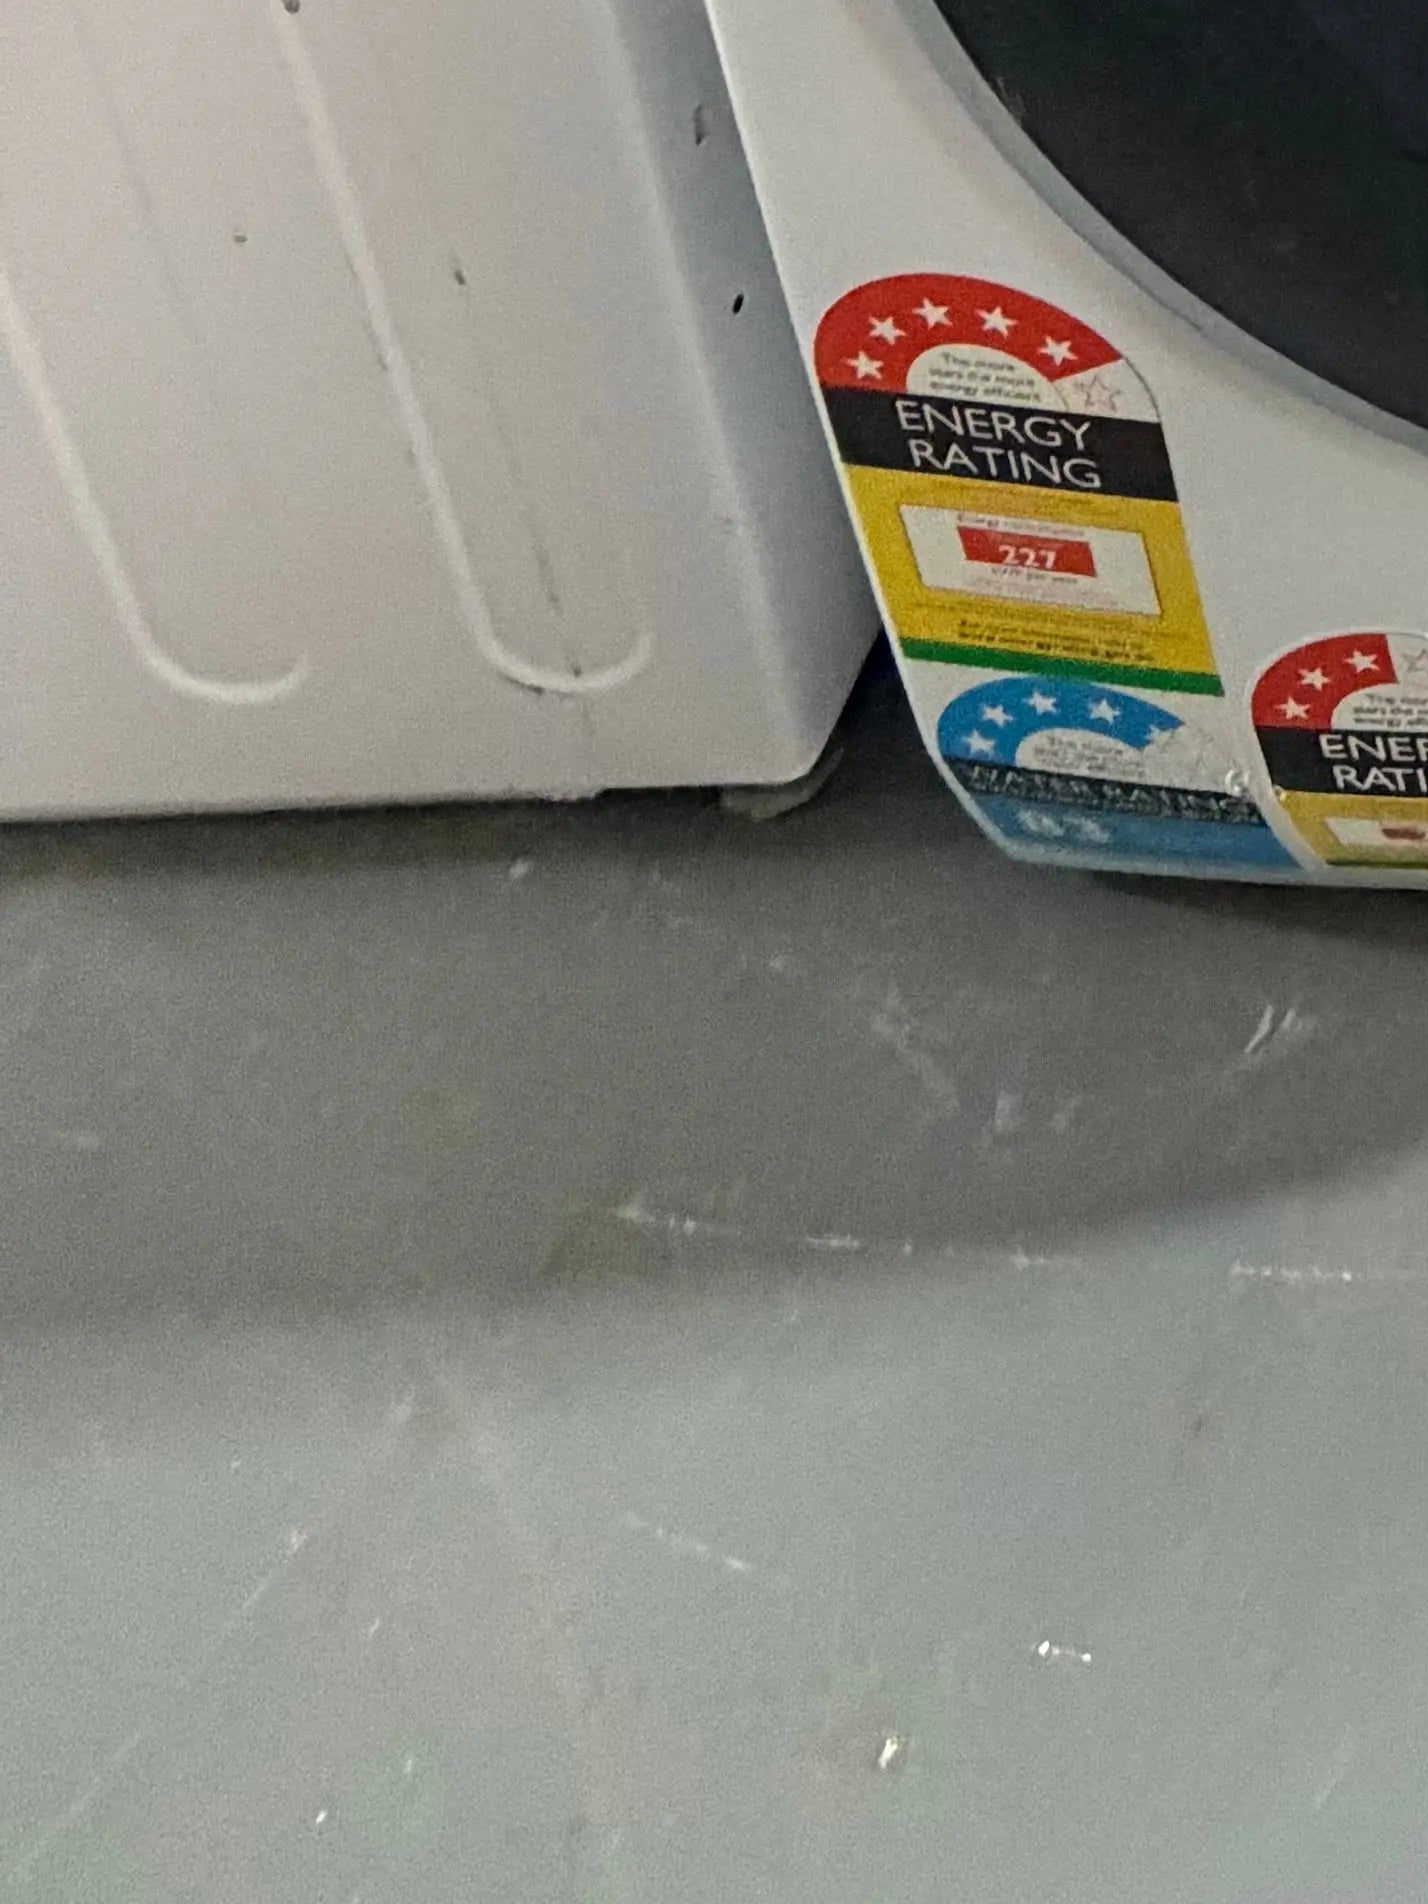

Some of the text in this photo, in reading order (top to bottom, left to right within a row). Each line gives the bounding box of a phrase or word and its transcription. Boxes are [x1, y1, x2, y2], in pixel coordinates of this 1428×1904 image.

[894, 399, 1092, 452] ENERGY
[907, 438, 1101, 489] RATING
[998, 544, 1057, 569] 227
